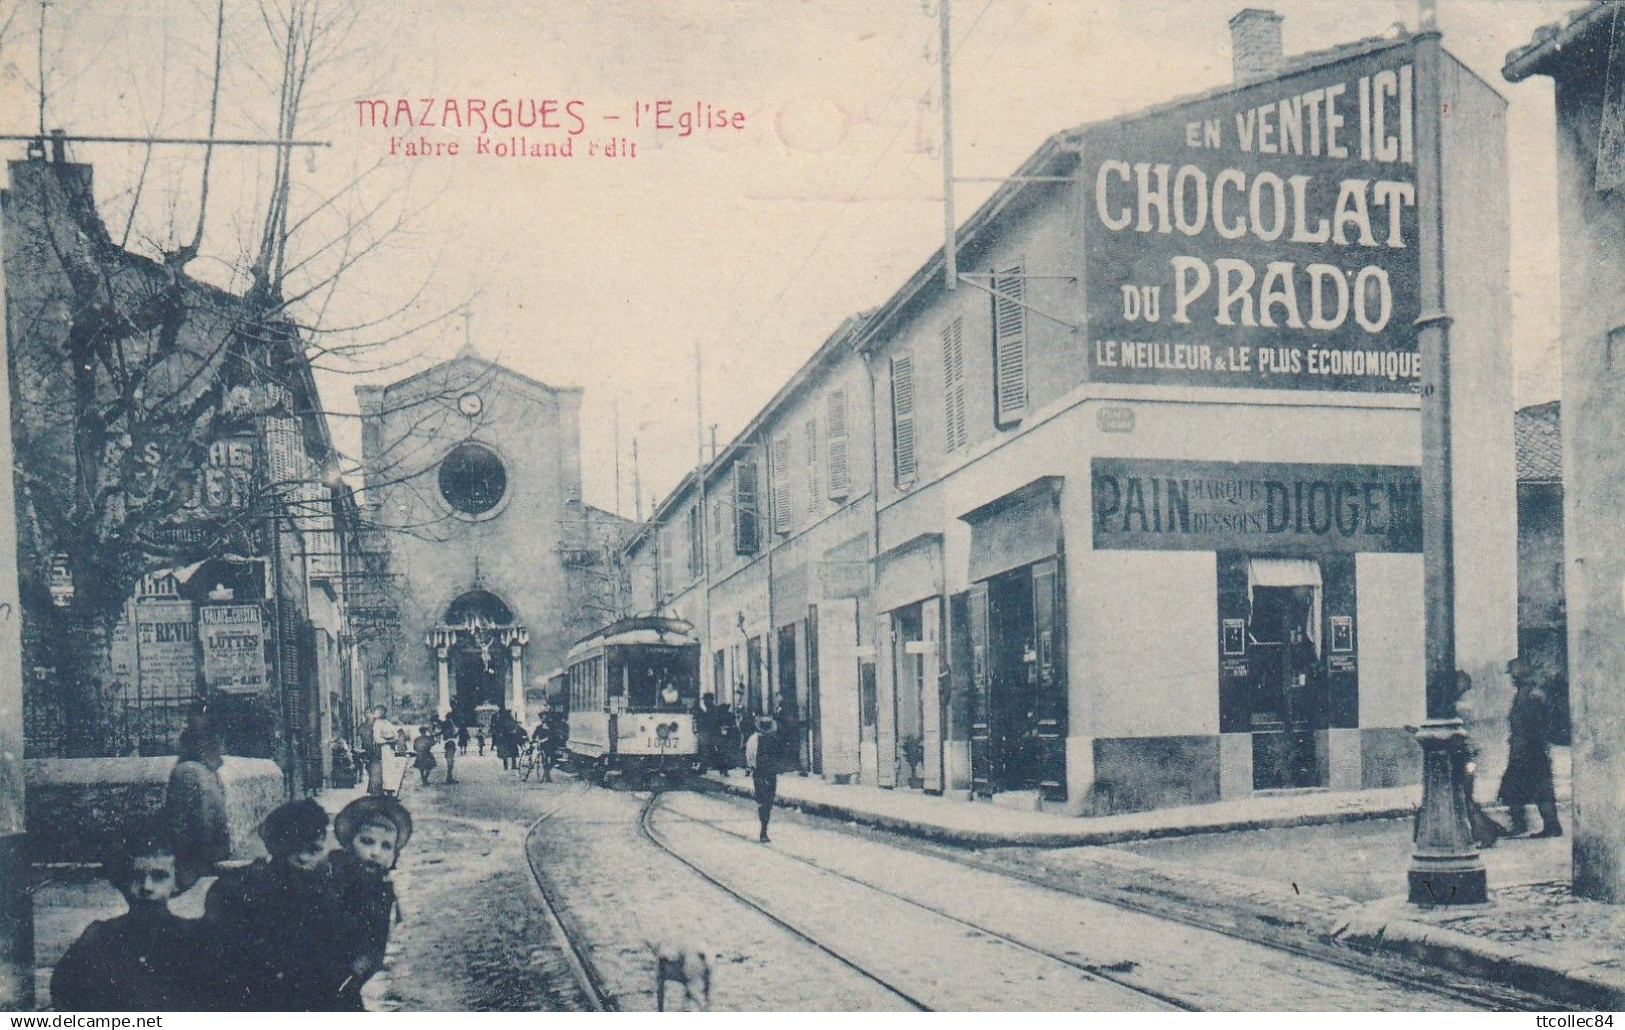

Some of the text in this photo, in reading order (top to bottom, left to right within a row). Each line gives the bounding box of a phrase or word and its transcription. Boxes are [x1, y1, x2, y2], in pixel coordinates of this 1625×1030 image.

[1185, 64, 1414, 163] EN VENTE ICI
[1095, 159, 1416, 248] CHOCOLAT
[1120, 255, 1393, 334] DU PRADO
[1096, 340, 1118, 367] LE
[1121, 341, 1212, 371] MEILLEUR
[1229, 346, 1251, 372] LE
[1258, 347, 1302, 374] PLUS
[1307, 344, 1421, 382] ÉCONOMIQUE
[1095, 474, 1191, 534] PAIN
[1263, 478, 1422, 538] DIOGEN
[208, 635, 259, 649] LUTTES
